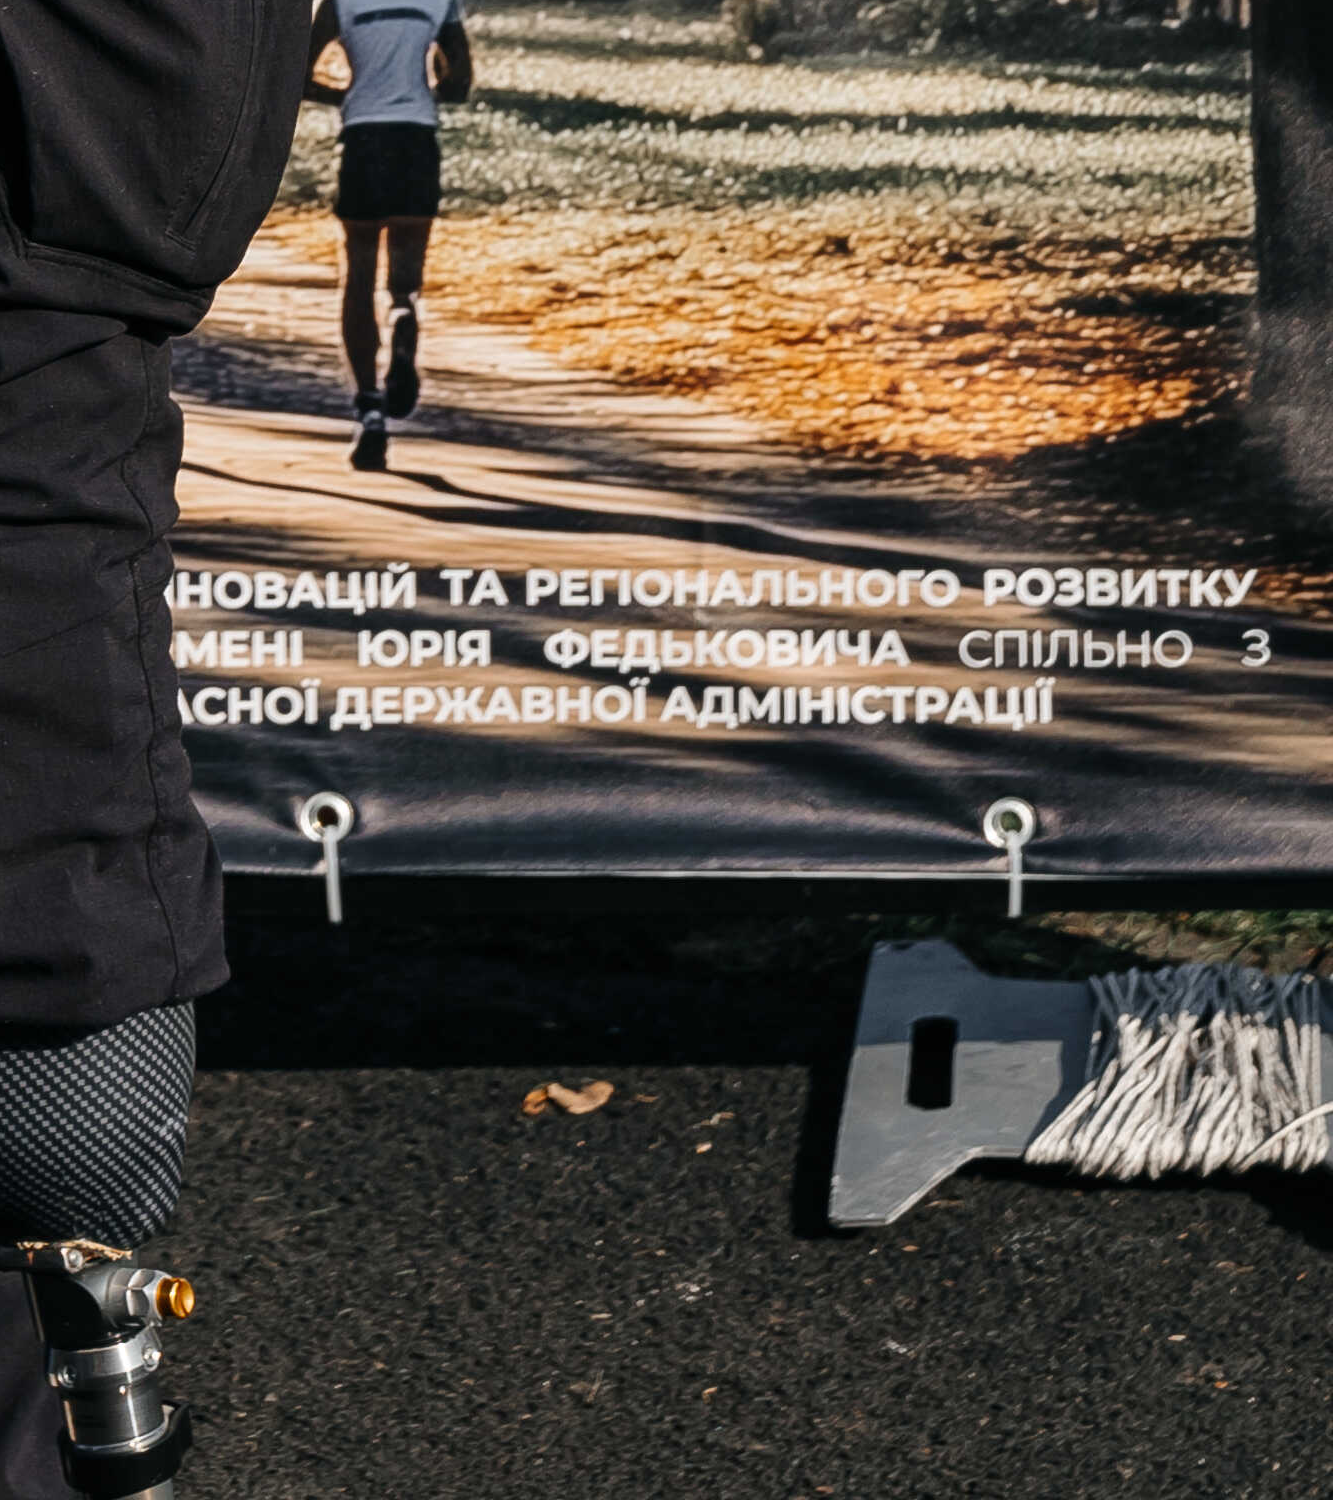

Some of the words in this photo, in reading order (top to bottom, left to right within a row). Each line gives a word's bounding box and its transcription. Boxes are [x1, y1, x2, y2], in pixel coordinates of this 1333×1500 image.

[164, 562, 417, 615] НОВАЦІЙ
[440, 568, 508, 607] ТА
[525, 567, 960, 607] РЕГІОНАЛЬНОГО
[983, 568, 1256, 607] РОЗВИТКУ
[357, 629, 491, 668] ЮРІЯ
[543, 628, 910, 674] ФЕДЬКОВИЧА
[958, 629, 1193, 668] СПІЛЬНО
[329, 677, 649, 731] ДЕРЖАВНОЇ
[660, 678, 1056, 731] АДМІНІСТРАЦІЇ
